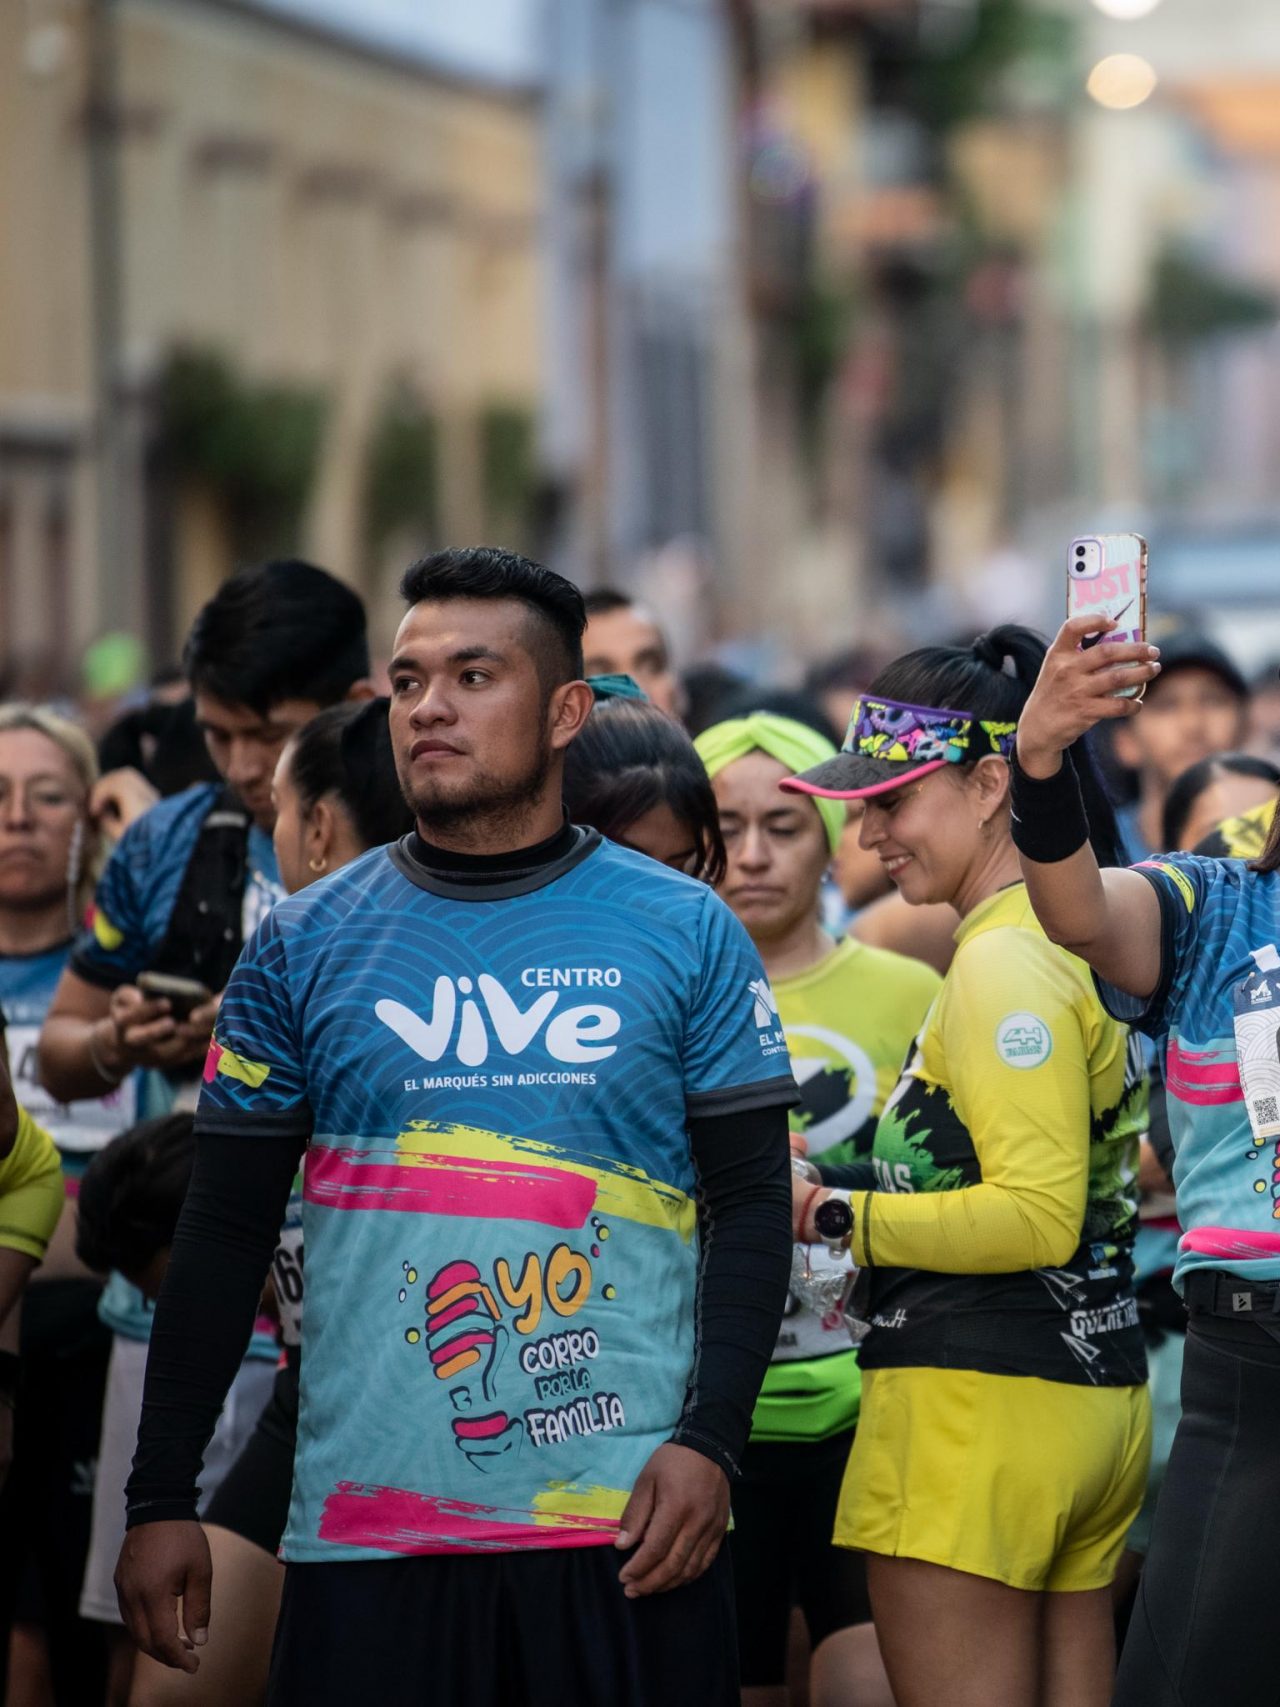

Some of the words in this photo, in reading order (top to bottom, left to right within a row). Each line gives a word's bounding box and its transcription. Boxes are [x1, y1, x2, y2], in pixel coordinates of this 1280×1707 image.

[521, 968, 621, 987] CENTRO
[760, 1033, 774, 1046] EL
[404, 1079, 420, 1091] EL
[423, 1073, 487, 1091] MARQUÉS
[492, 1075, 513, 1087] SIN
[517, 1072, 597, 1086] ADICCIONES
[519, 1327, 600, 1374] CORRO
[534, 1371, 571, 1400] POR
[570, 1367, 592, 1392] LA
[524, 1391, 626, 1448] FAMILIA
